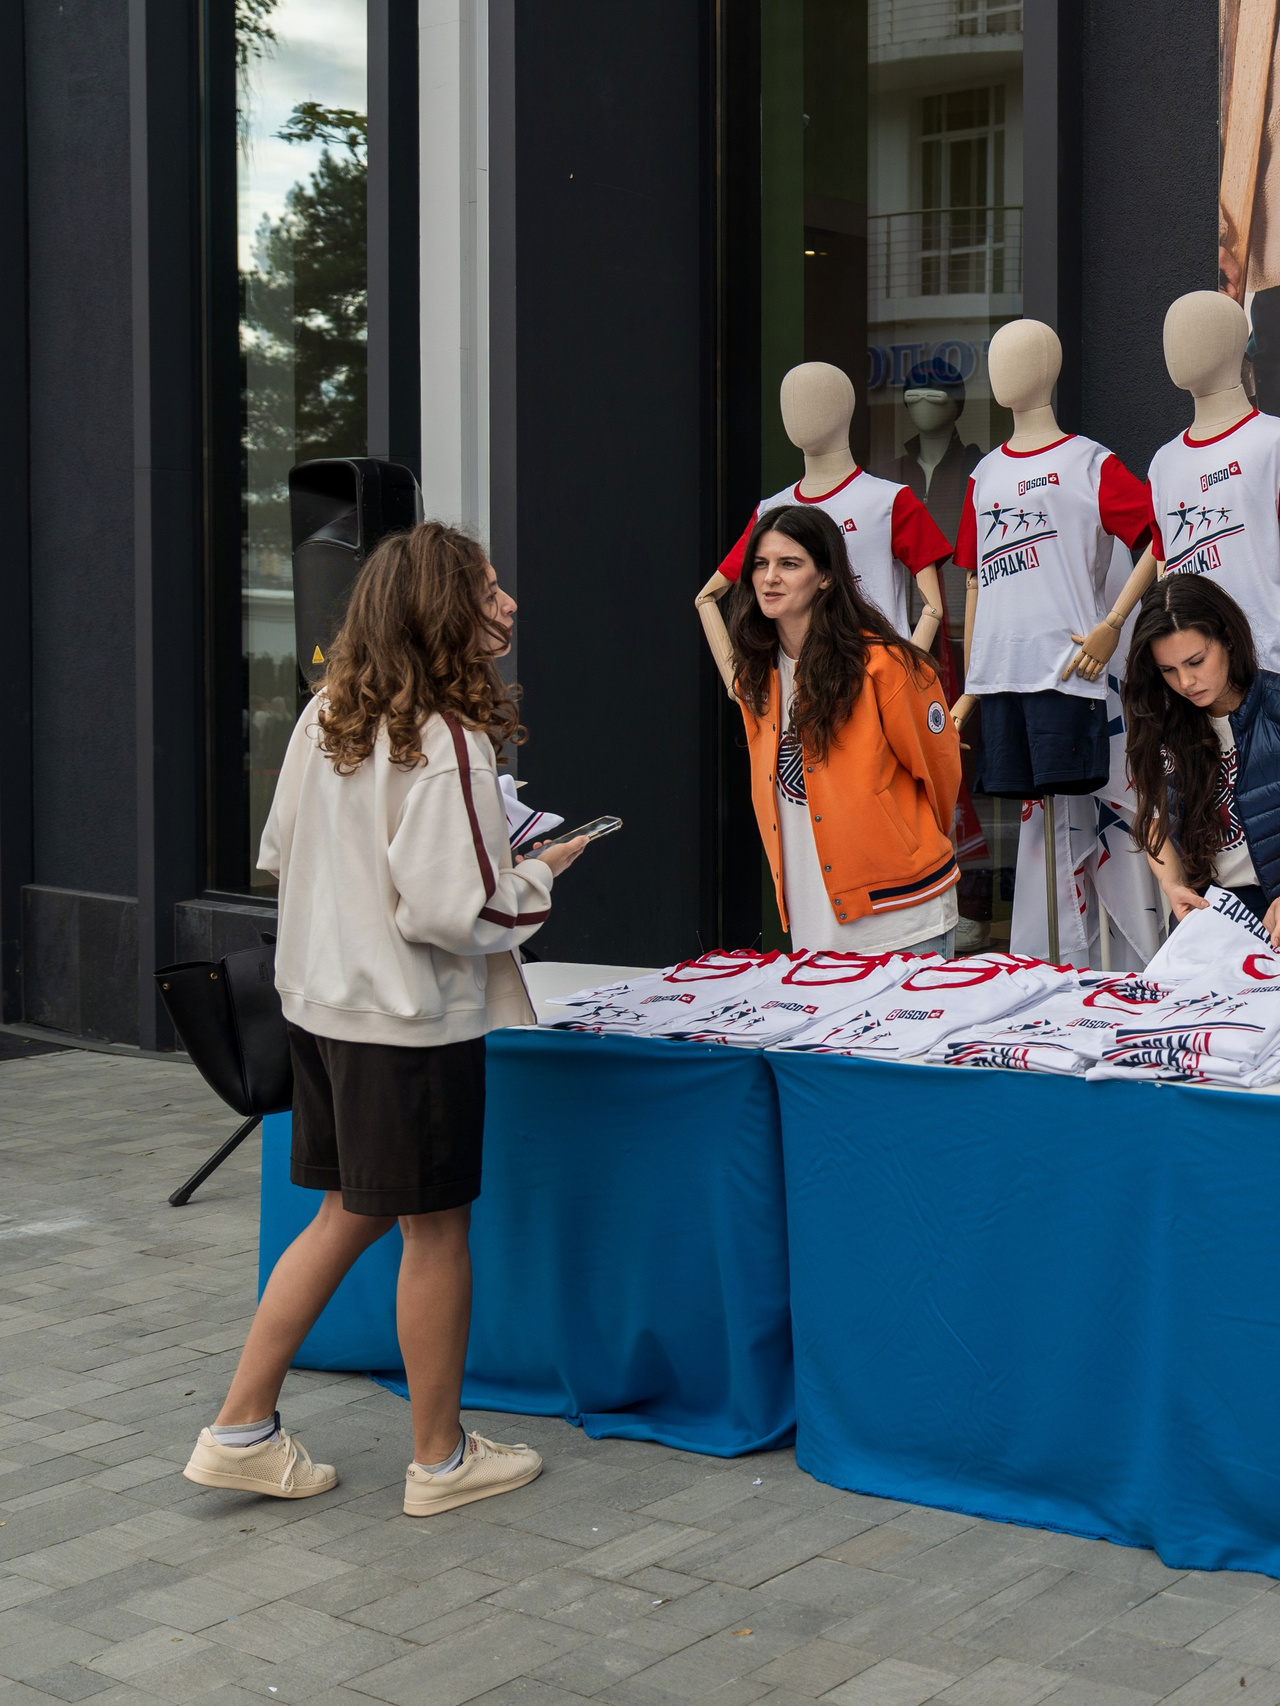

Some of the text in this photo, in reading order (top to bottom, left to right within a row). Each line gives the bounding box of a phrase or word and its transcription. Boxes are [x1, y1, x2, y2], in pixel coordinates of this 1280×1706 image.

[1018, 476, 1047, 496] BOSCO
[1200, 467, 1229, 493] BOSCO
[981, 546, 1040, 588] ЗАРЯДКА
[884, 1008, 930, 1021] BOSCO
